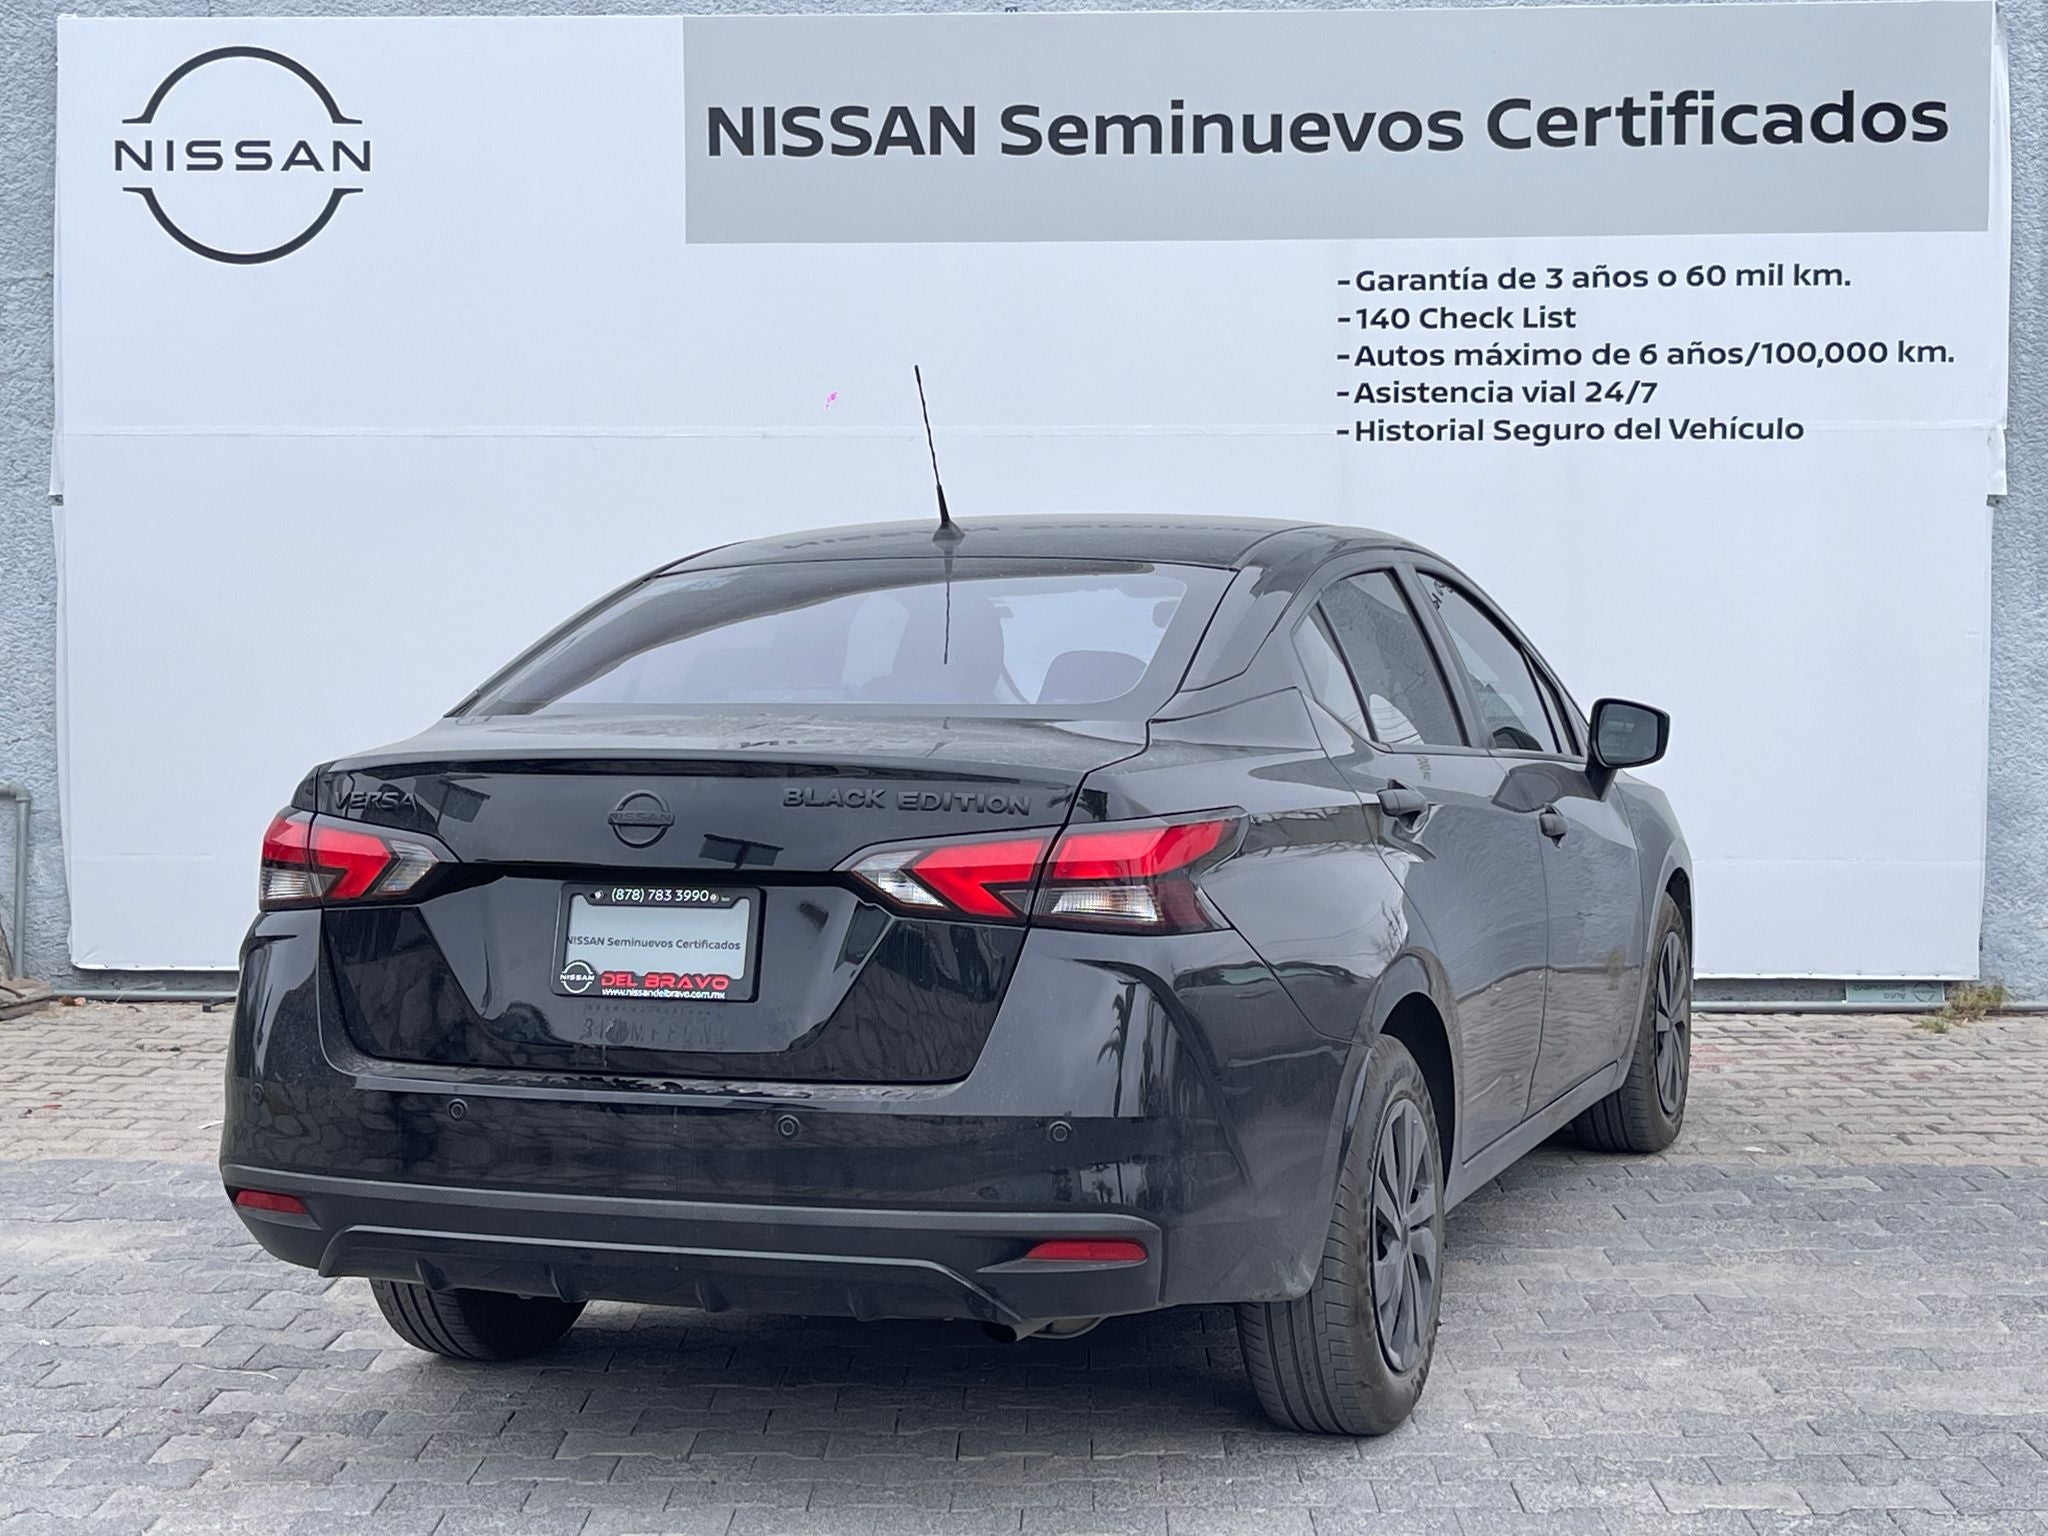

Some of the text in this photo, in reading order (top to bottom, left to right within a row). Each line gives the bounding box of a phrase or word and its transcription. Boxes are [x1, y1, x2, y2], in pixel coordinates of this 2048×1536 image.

[707, 89, 1949, 157] NISSAN Seminuevos Certificados
[115, 140, 372, 172] NISSAN
[1497, 267, 1536, 290] de
[1545, 267, 1563, 289] 3
[1572, 264, 1649, 289] años
[1657, 269, 1677, 287] o
[1686, 265, 1726, 287] 60
[1736, 262, 1784, 286] mil
[1793, 263, 1851, 287] km.
[1419, 306, 1514, 329] Check
[1523, 305, 1577, 329] List
[1454, 342, 1582, 366] máximo
[1592, 342, 1631, 366] de
[1639, 343, 1658, 366] 6
[1667, 341, 1888, 369] años/100,000
[1898, 340, 1954, 363] km.
[1521, 379, 1575, 403] vial
[1585, 380, 1658, 405] 24/7
[1493, 419, 1605, 447] Seguro
[1614, 417, 1661, 440] del
[1668, 415, 1804, 440] Vehículo
[334, 791, 417, 812] VERSA
[783, 787, 1031, 816] BLACK EDITION
[609, 813, 673, 823] NISSAN
[611, 888, 645, 902] (878)
[648, 889, 672, 901] 783
[675, 890, 709, 902] 3990
[607, 937, 673, 948] Seminuevos
[676, 939, 741, 950] Certificados
[601, 973, 729, 990] DEL BRAVO
